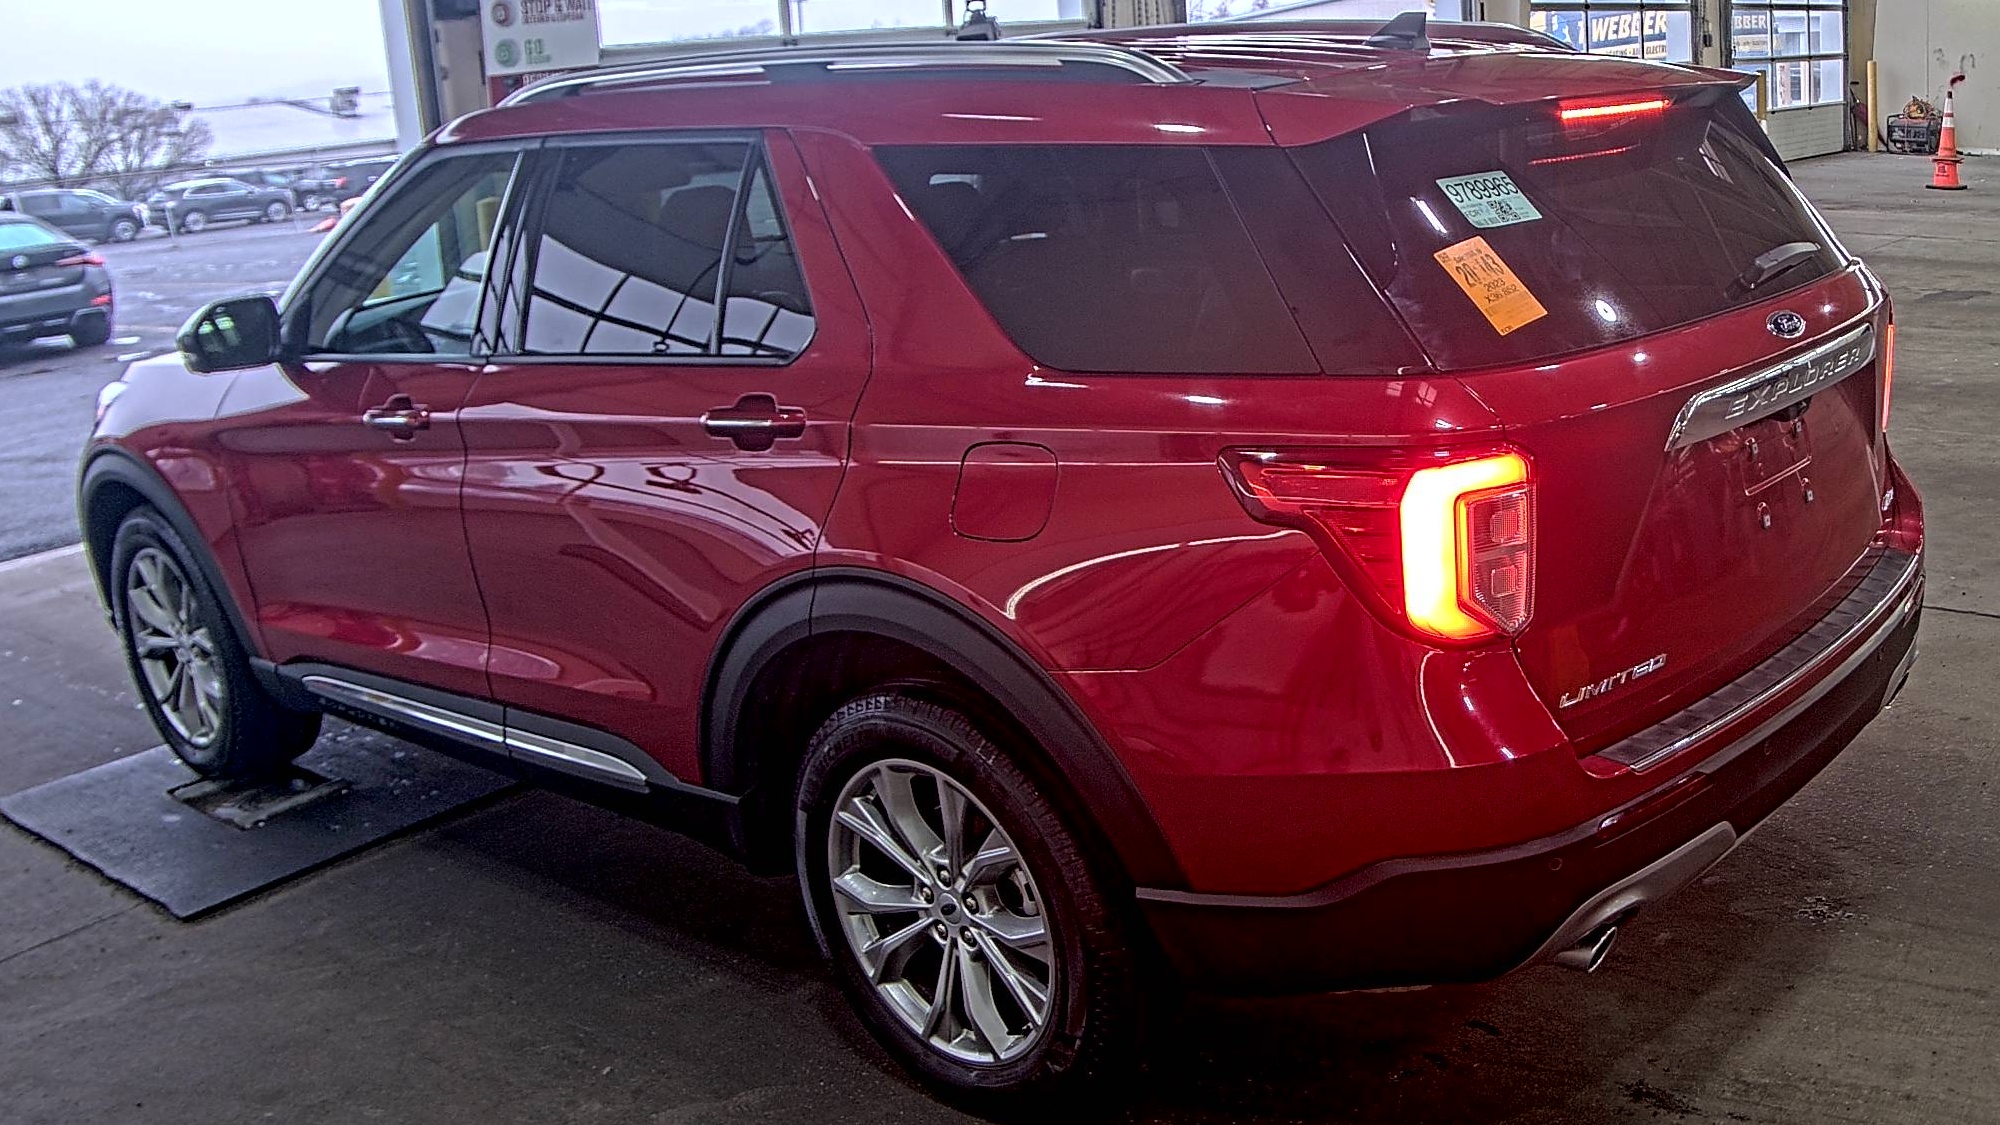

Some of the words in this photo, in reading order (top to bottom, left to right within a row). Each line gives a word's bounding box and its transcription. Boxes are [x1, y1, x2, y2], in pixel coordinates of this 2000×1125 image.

[1445, 176, 1519, 203] 9789965
[1724, 346, 1861, 420] EXPLORER
[1559, 653, 1668, 708] LIMITED
